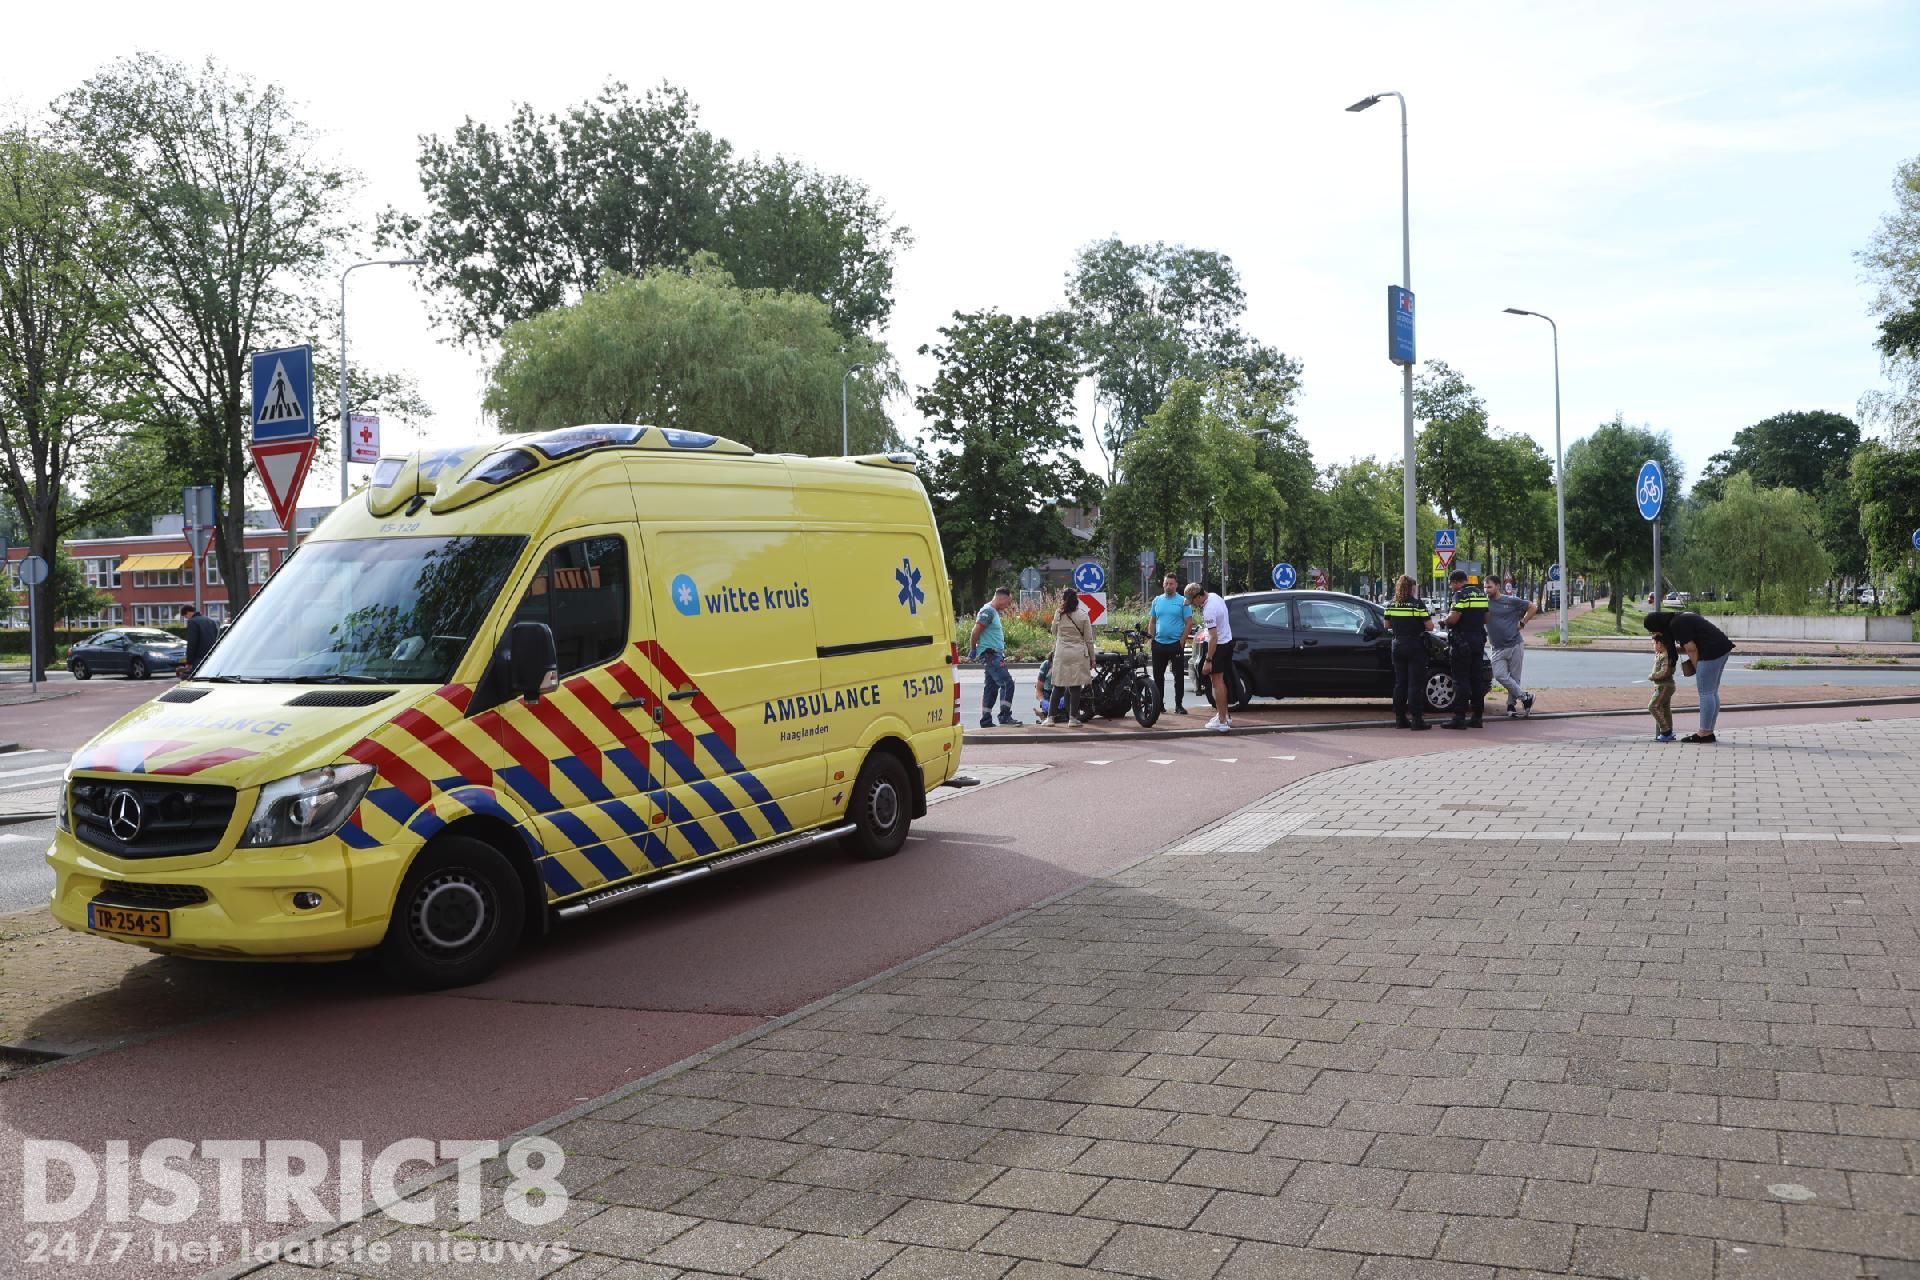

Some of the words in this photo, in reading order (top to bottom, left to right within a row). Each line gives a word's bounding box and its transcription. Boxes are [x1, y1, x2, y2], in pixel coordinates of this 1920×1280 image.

[704, 585, 760, 614] witte
[764, 581, 810, 610] kruis
[902, 674, 944, 699] 15-120
[763, 684, 881, 724] AMBULANCE
[780, 724, 830, 741] Haaglanden
[95, 909, 161, 933] TR-254-S
